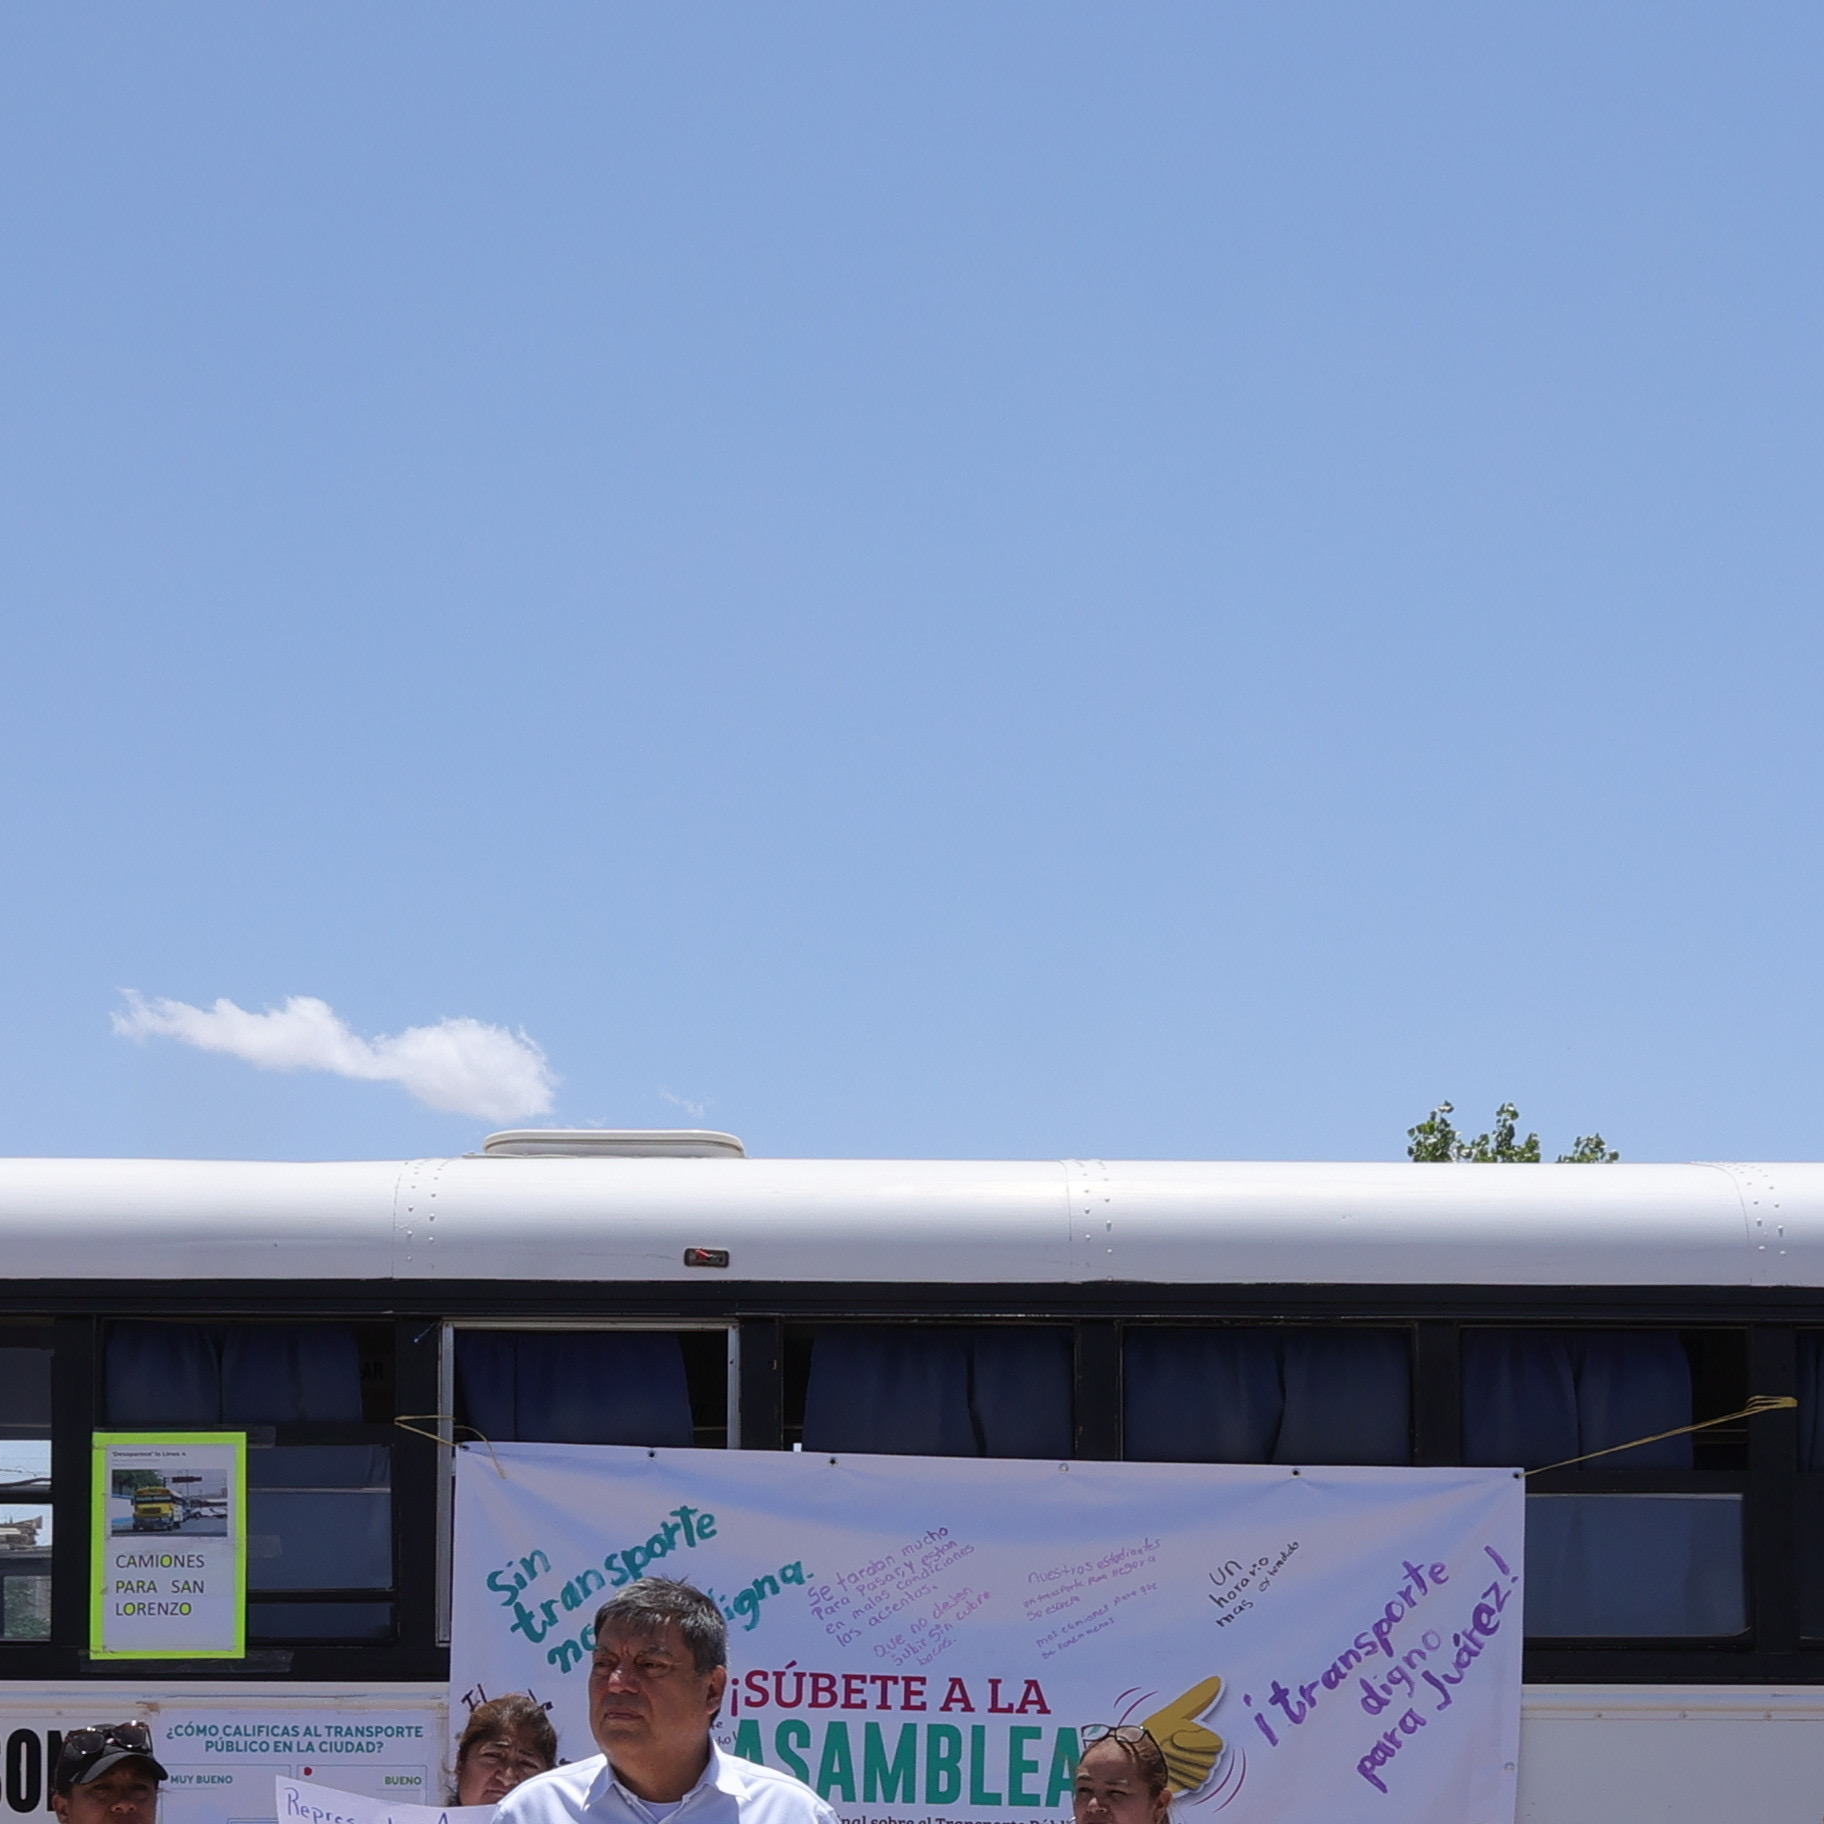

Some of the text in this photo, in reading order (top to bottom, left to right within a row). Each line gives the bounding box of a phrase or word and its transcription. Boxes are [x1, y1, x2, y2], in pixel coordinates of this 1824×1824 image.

[901, 1527, 949, 1557] mucho
[115, 1554, 205, 1568] CAMIONES
[510, 1505, 718, 1644] transporte
[115, 1580, 205, 1594] PARA SAN
[486, 1549, 551, 1608] Sin
[115, 1602, 192, 1616] LORENZO
[826, 1589, 891, 1635] en malas
[1216, 1598, 1254, 1628] mas
[836, 1627, 862, 1648] los
[873, 1618, 928, 1658] Que no
[1356, 1545, 1519, 1794] para Juárez!
[1359, 1629, 1442, 1716] digno
[730, 1660, 1051, 1716] ¡SÚBETE A LA
[165, 1722, 424, 1740] ¿CÓMO CALIFICAS AL TRANSPORTE
[205, 1737, 384, 1754] PÚBLICO EN LA CIUDAD?
[170, 1775, 423, 1786] MUY BUENO BUENO
